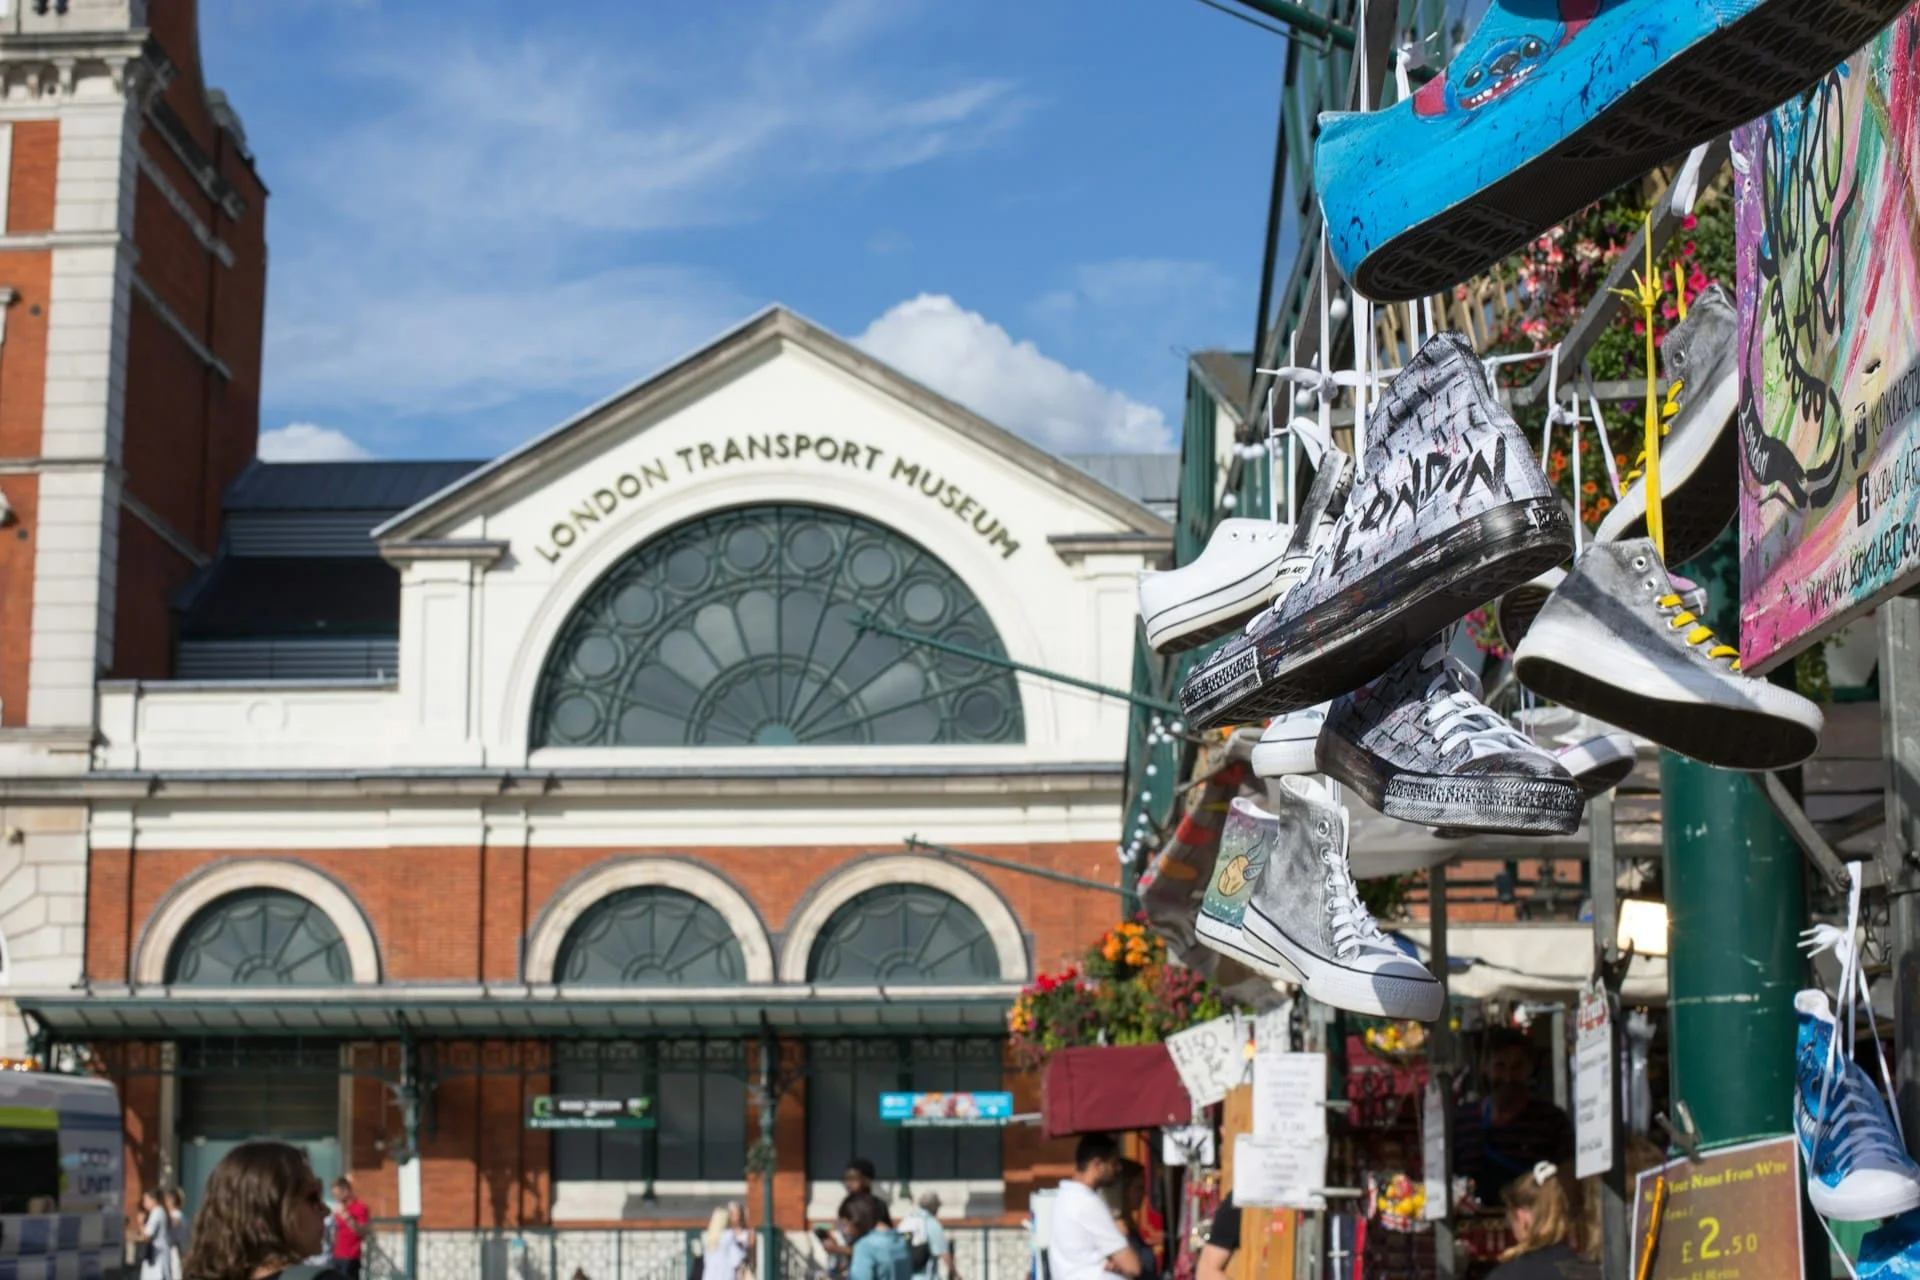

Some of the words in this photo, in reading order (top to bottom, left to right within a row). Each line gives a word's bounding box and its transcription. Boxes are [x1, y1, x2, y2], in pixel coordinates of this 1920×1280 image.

[1903, 446, 1920, 494] AR
[534, 458, 669, 564] LONDON
[676, 433, 884, 474] TRANSPORT
[890, 456, 1021, 560] MUSEUM
[1681, 1216, 1758, 1264] £2.50
